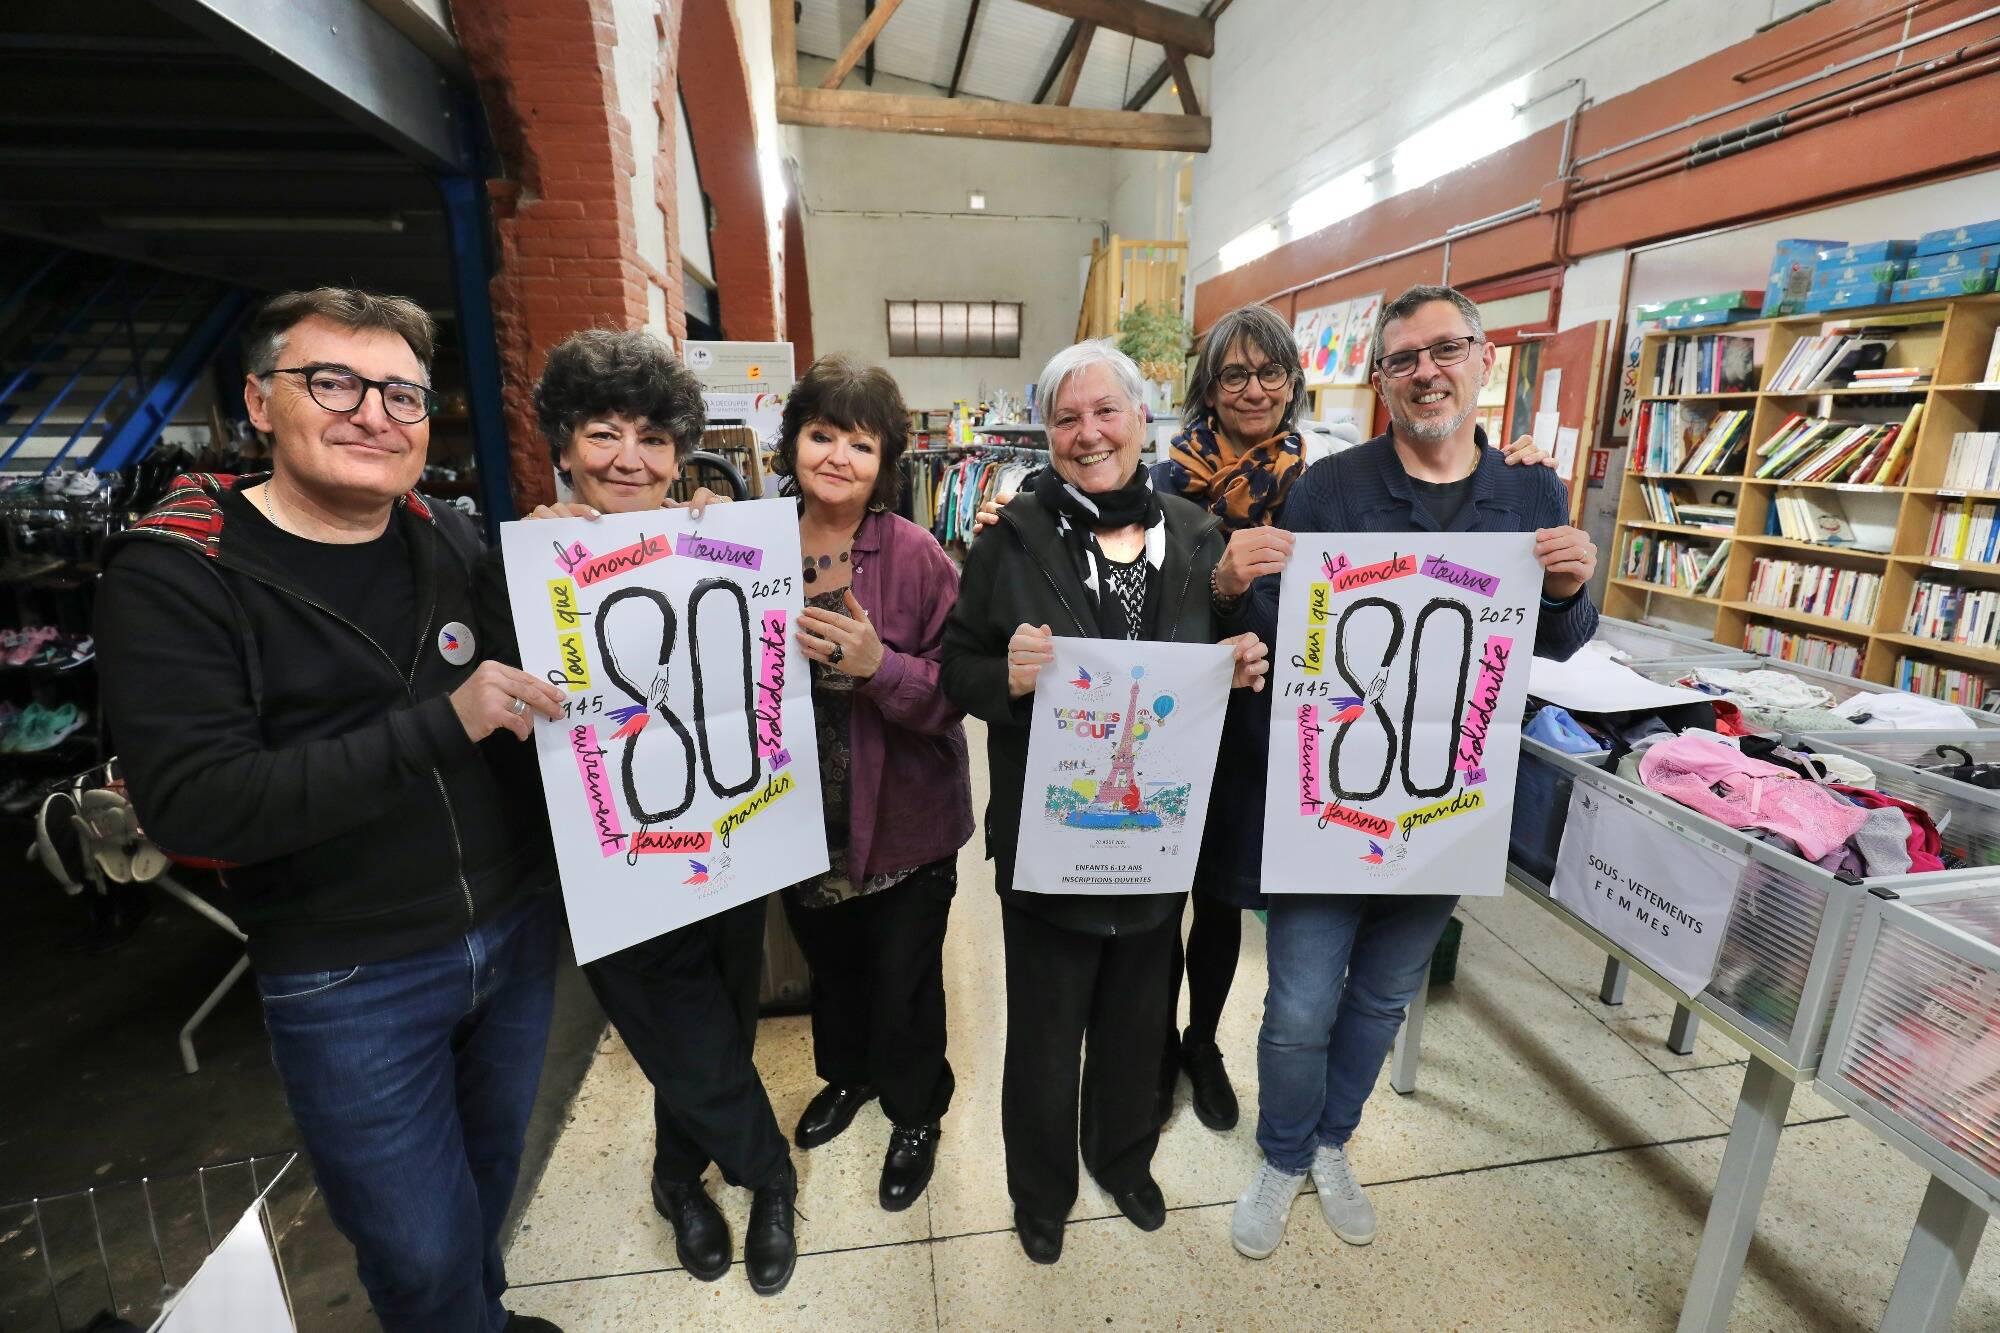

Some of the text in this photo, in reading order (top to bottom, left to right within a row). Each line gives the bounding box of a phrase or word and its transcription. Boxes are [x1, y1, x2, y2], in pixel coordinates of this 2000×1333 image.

[582, 533, 665, 586] monde
[687, 531, 756, 567] tourne
[1340, 552, 1411, 590] monde
[1427, 555, 1491, 590] tourne
[752, 577, 792, 599] 2025
[553, 585, 591, 622] que
[1313, 588, 1337, 620] que
[1479, 607, 1526, 625] 2025
[1284, 681, 1329, 698] 1945
[549, 695, 604, 723] 945
[1053, 707, 1121, 723] VACANCES
[1075, 722, 1117, 740] OUF
[627, 775, 790, 867] faisons grandir
[1318, 788, 1480, 841] faisons grandir
